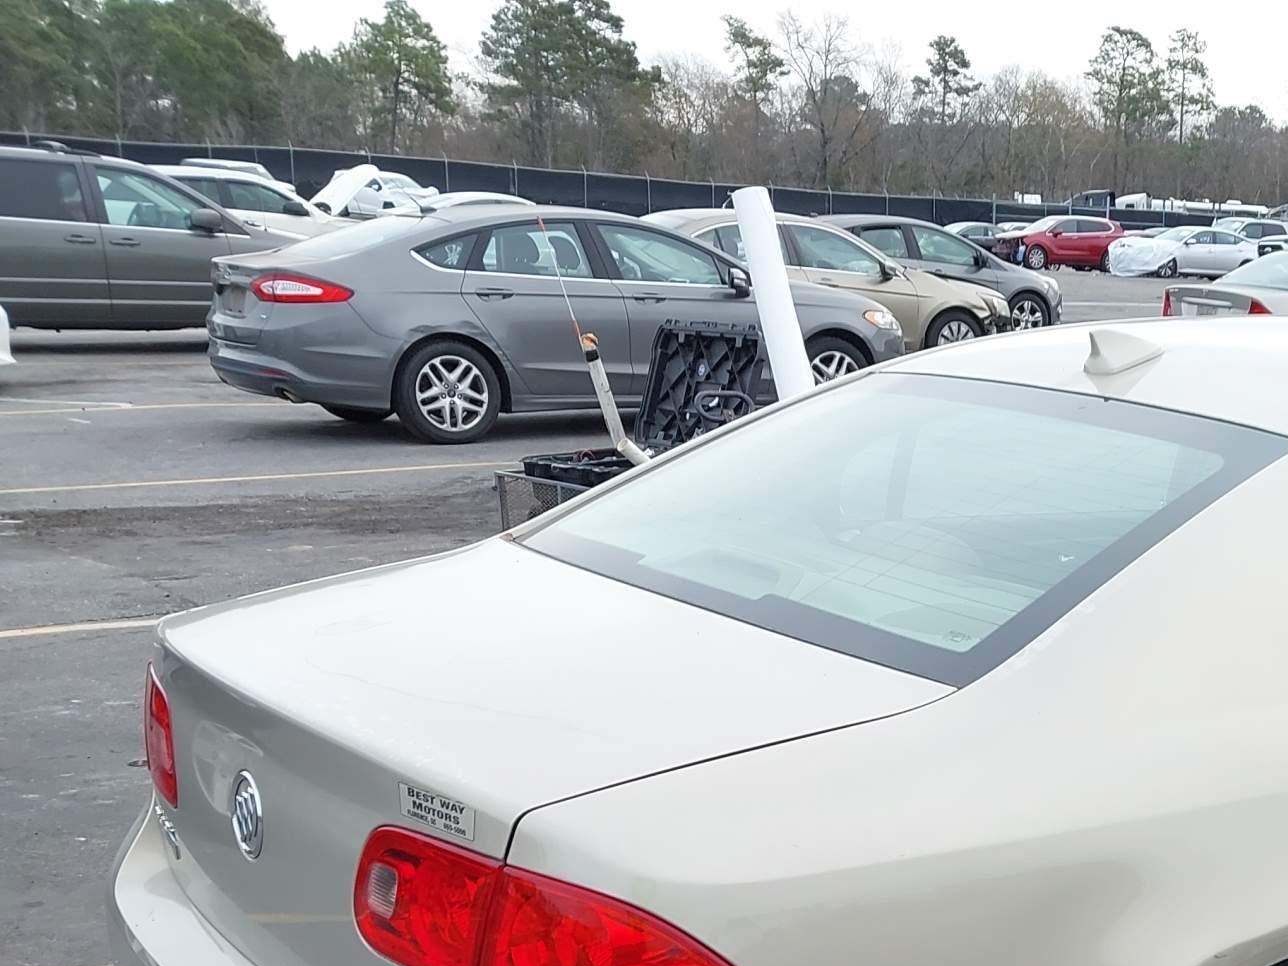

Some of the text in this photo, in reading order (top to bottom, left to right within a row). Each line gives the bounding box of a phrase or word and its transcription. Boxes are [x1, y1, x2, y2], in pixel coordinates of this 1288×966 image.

[407, 787, 465, 815] BEST WAY
[412, 800, 460, 825] MOTORS
